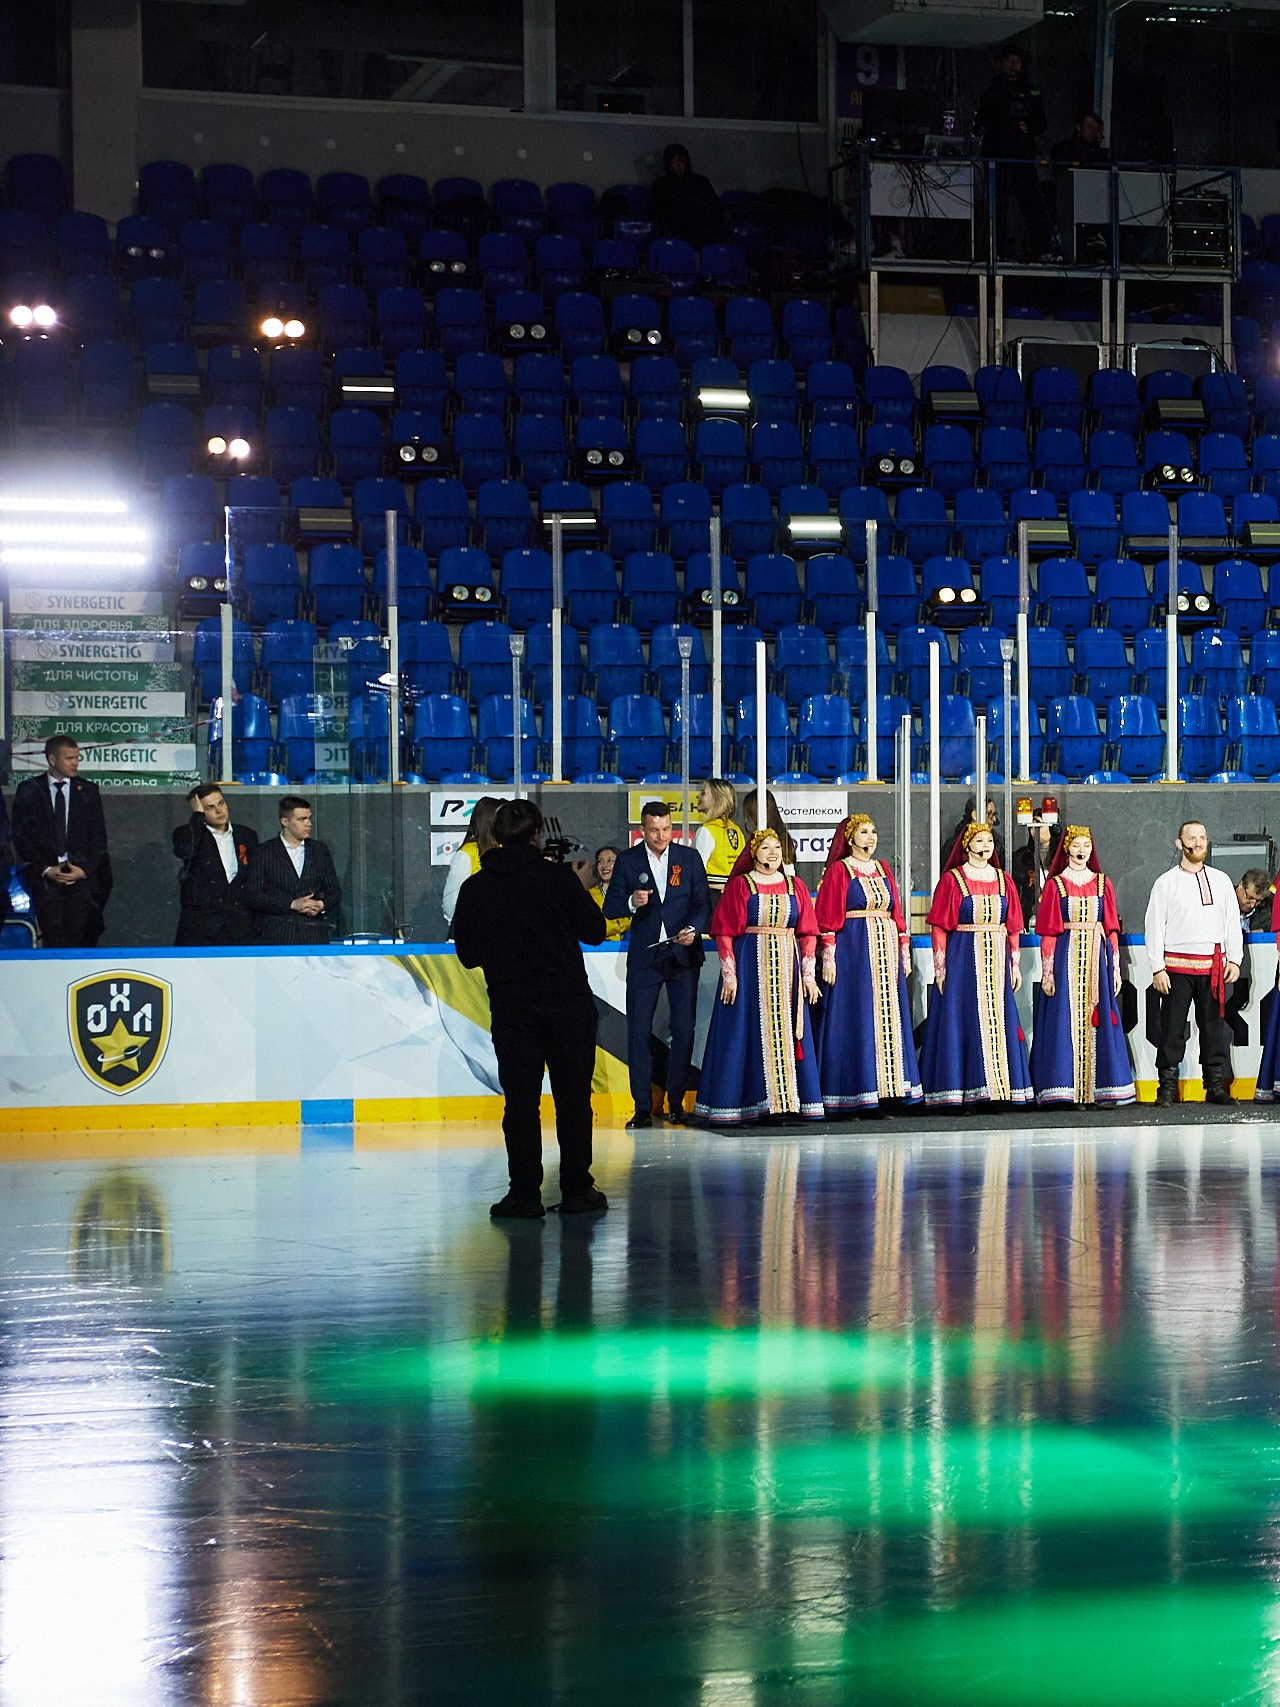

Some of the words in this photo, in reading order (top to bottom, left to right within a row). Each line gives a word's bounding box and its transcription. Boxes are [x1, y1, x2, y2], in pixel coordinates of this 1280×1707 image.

[856, 45, 880, 86] 9
[47, 595, 125, 610] SYNERGETIC
[33, 619, 61, 631] ДЛЯ
[63, 620, 134, 632] ЗДОРОВЬЯ
[59, 644, 140, 658] SYNERGETIC
[45, 670, 73, 682] ДЛЯ
[76, 670, 139, 681] ЧИСТОТЫ
[67, 695, 148, 710] SYNERGETIC
[54, 722, 83, 734] ДЛЯ
[86, 722, 149, 733] КРАСОТЫ
[78, 749, 158, 763] SYNERGETIC
[777, 806, 842, 816] Ростелеком
[86, 982, 153, 1034] ОХЛ
